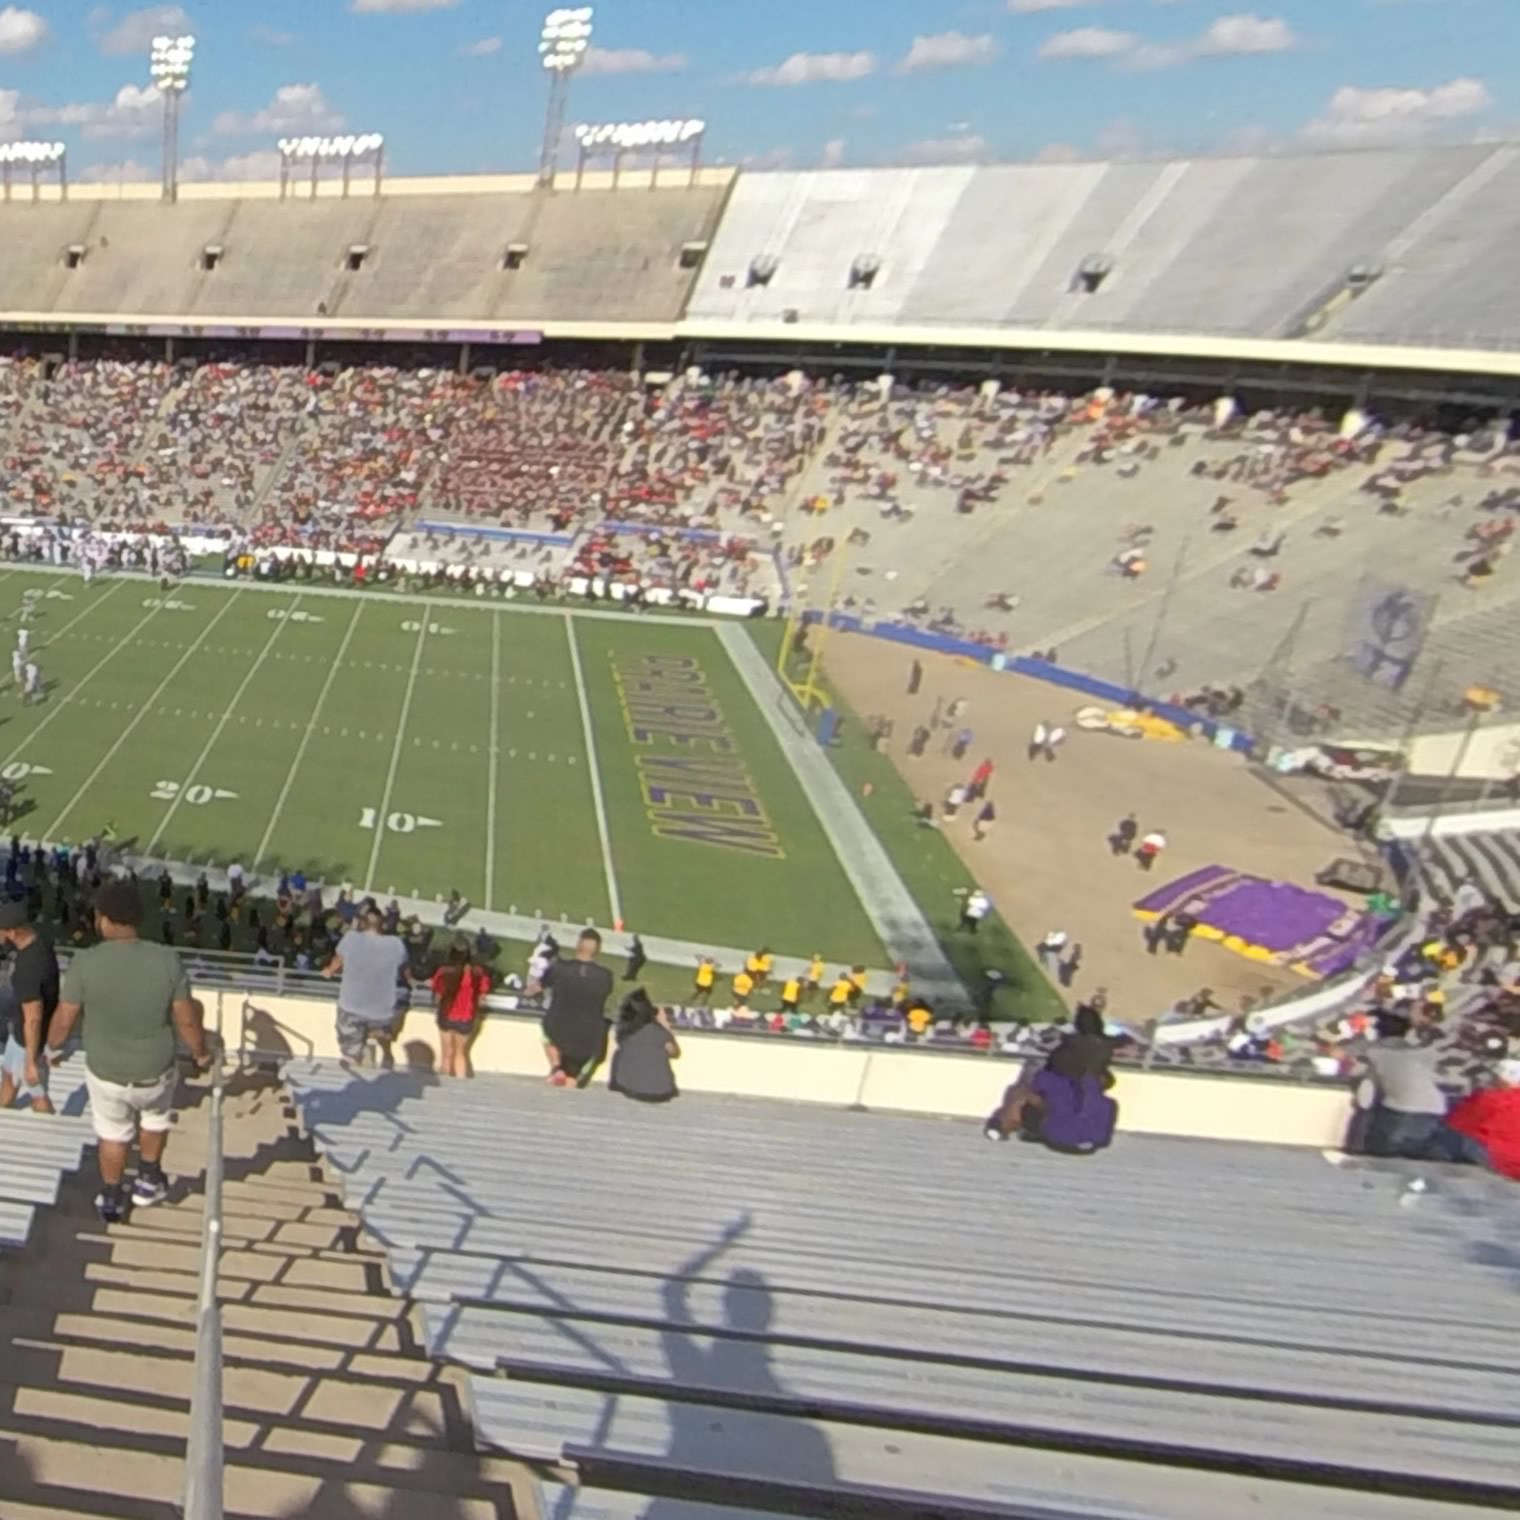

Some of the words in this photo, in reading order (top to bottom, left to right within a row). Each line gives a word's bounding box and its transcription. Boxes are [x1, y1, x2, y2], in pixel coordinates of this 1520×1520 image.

[608, 650, 738, 753] PRAIRIE
[150, 779, 213, 804] 20
[358, 807, 416, 833] 10
[634, 755, 786, 859] VIEW
